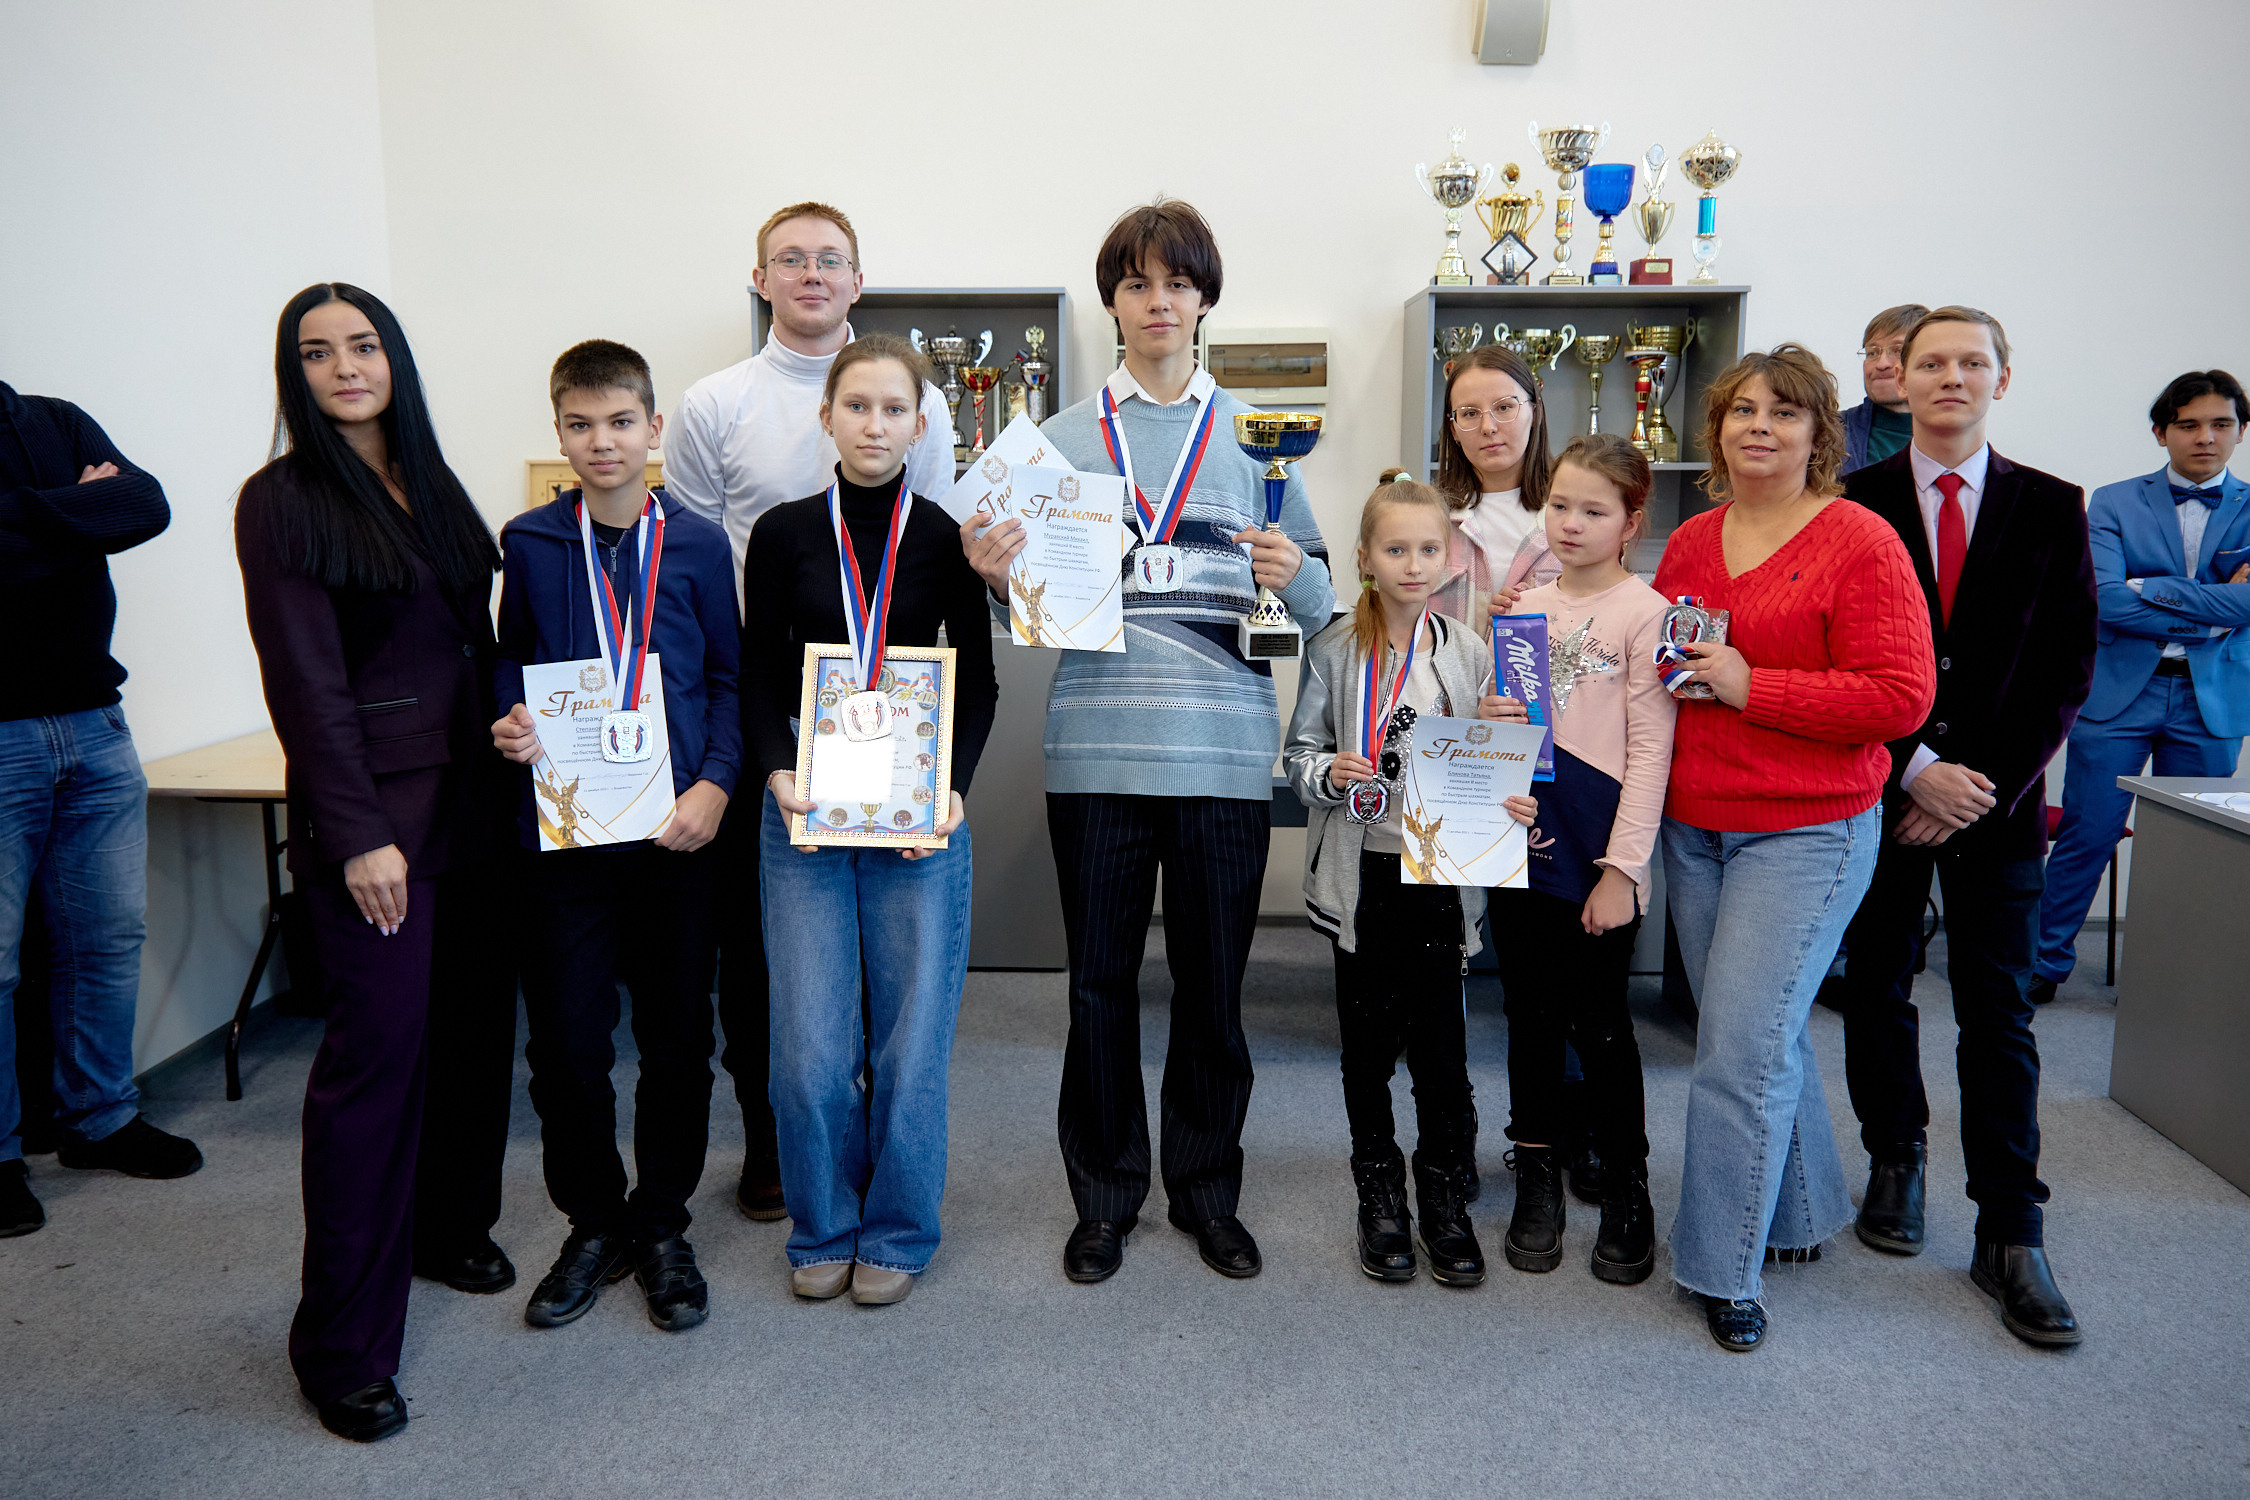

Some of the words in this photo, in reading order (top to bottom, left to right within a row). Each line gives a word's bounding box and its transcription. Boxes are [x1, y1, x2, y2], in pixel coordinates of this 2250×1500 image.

[976, 447, 1045, 528] Грата
[1021, 494, 1113, 523] Грамота
[1046, 523, 1088, 533] Награждается
[1582, 637, 1620, 667] Florida
[1505, 637, 1543, 703] Milka
[539, 691, 652, 718] Грама
[1421, 738, 1527, 762] Грамота
[1448, 762, 1495, 771] Награждается
